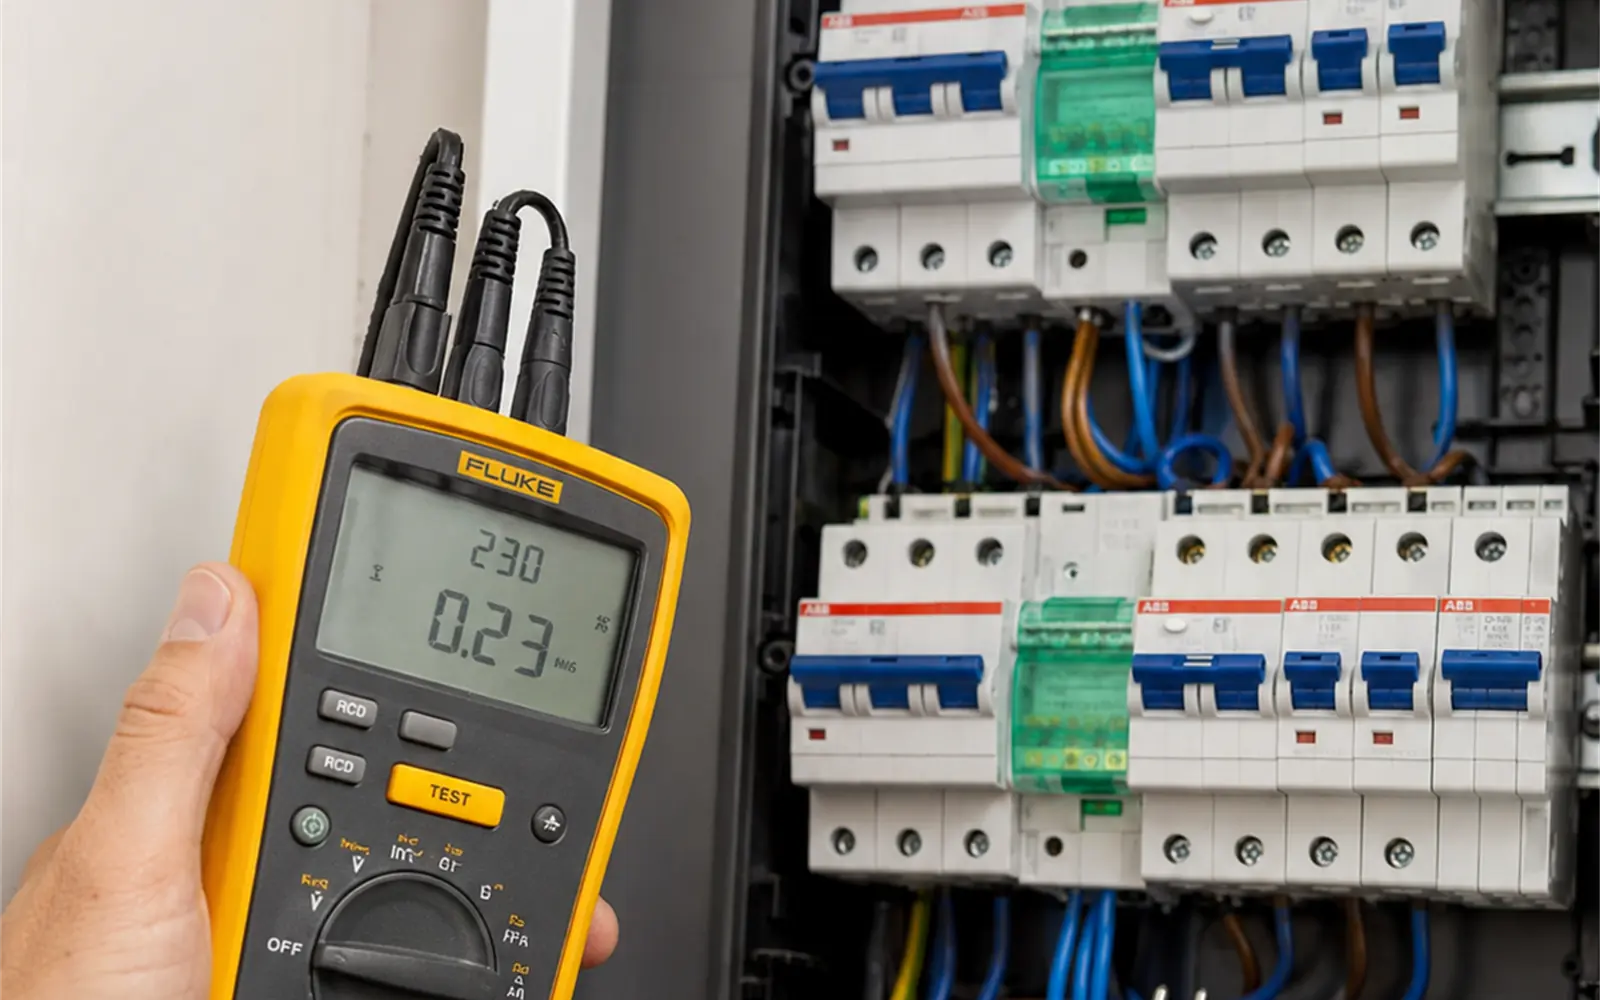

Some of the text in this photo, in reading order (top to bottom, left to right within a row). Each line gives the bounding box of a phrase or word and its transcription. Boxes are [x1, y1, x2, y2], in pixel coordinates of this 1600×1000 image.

[465, 457, 556, 498] FLUKE
[470, 529, 544, 584] 230
[1142, 600, 1169, 612] ABB
[1290, 599, 1318, 611] ABB
[1444, 600, 1474, 611] ABB
[428, 588, 553, 678] 0.23
[336, 700, 366, 718] RCD
[324, 756, 354, 773] RCD
[430, 784, 471, 806] TEST
[267, 937, 303, 956] OFF
